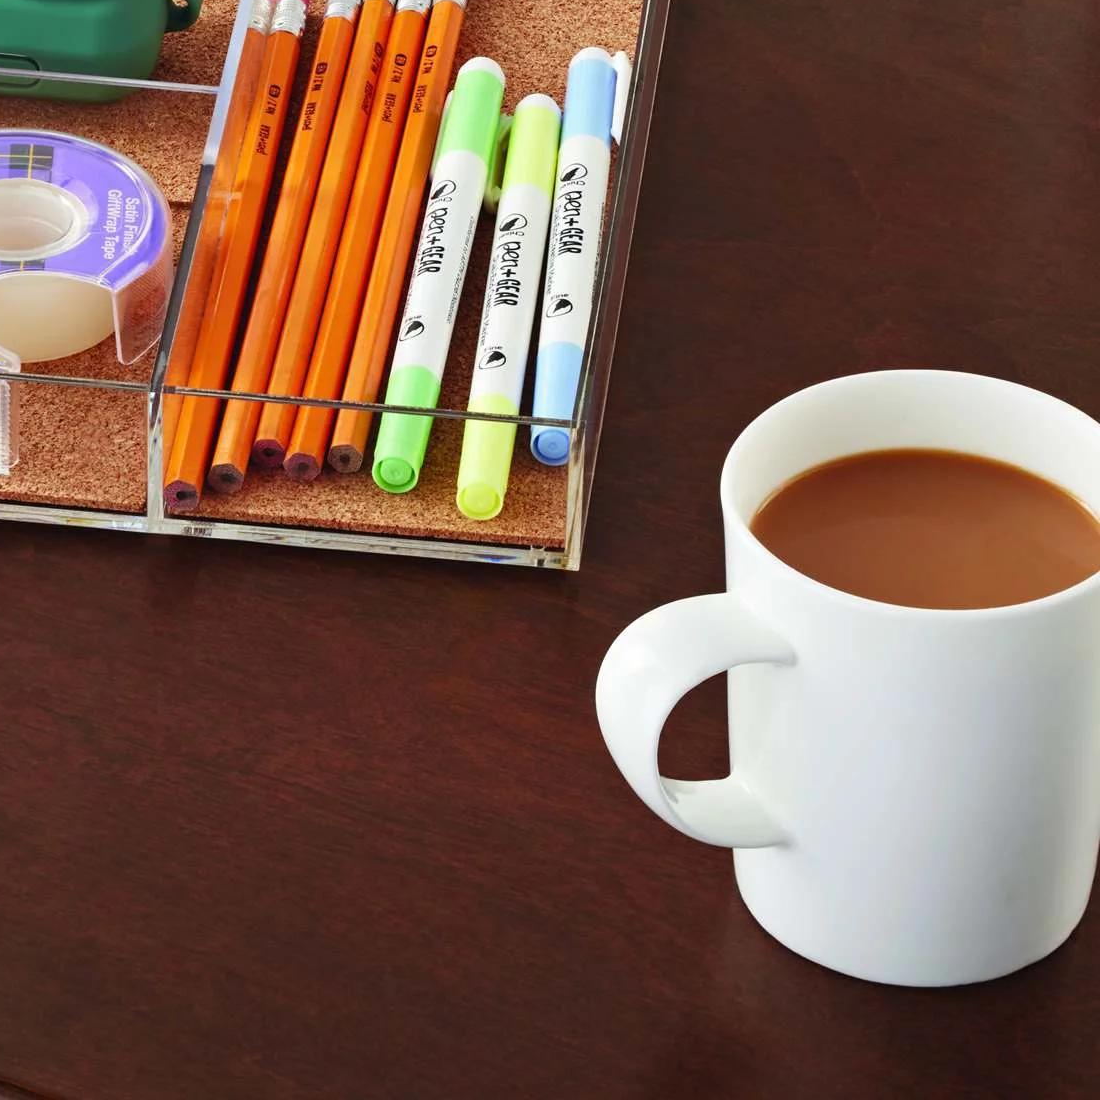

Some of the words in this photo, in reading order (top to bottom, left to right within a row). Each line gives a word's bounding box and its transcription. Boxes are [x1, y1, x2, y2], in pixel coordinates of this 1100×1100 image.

[125, 197, 140, 223] Satin
[557, 190, 584, 256] pen+GEAR
[101, 235, 119, 260] Tape
[123, 225, 139, 249] Finis
[417, 207, 448, 277] pen+GEAR
[494, 241, 521, 307] pen+GEAR
